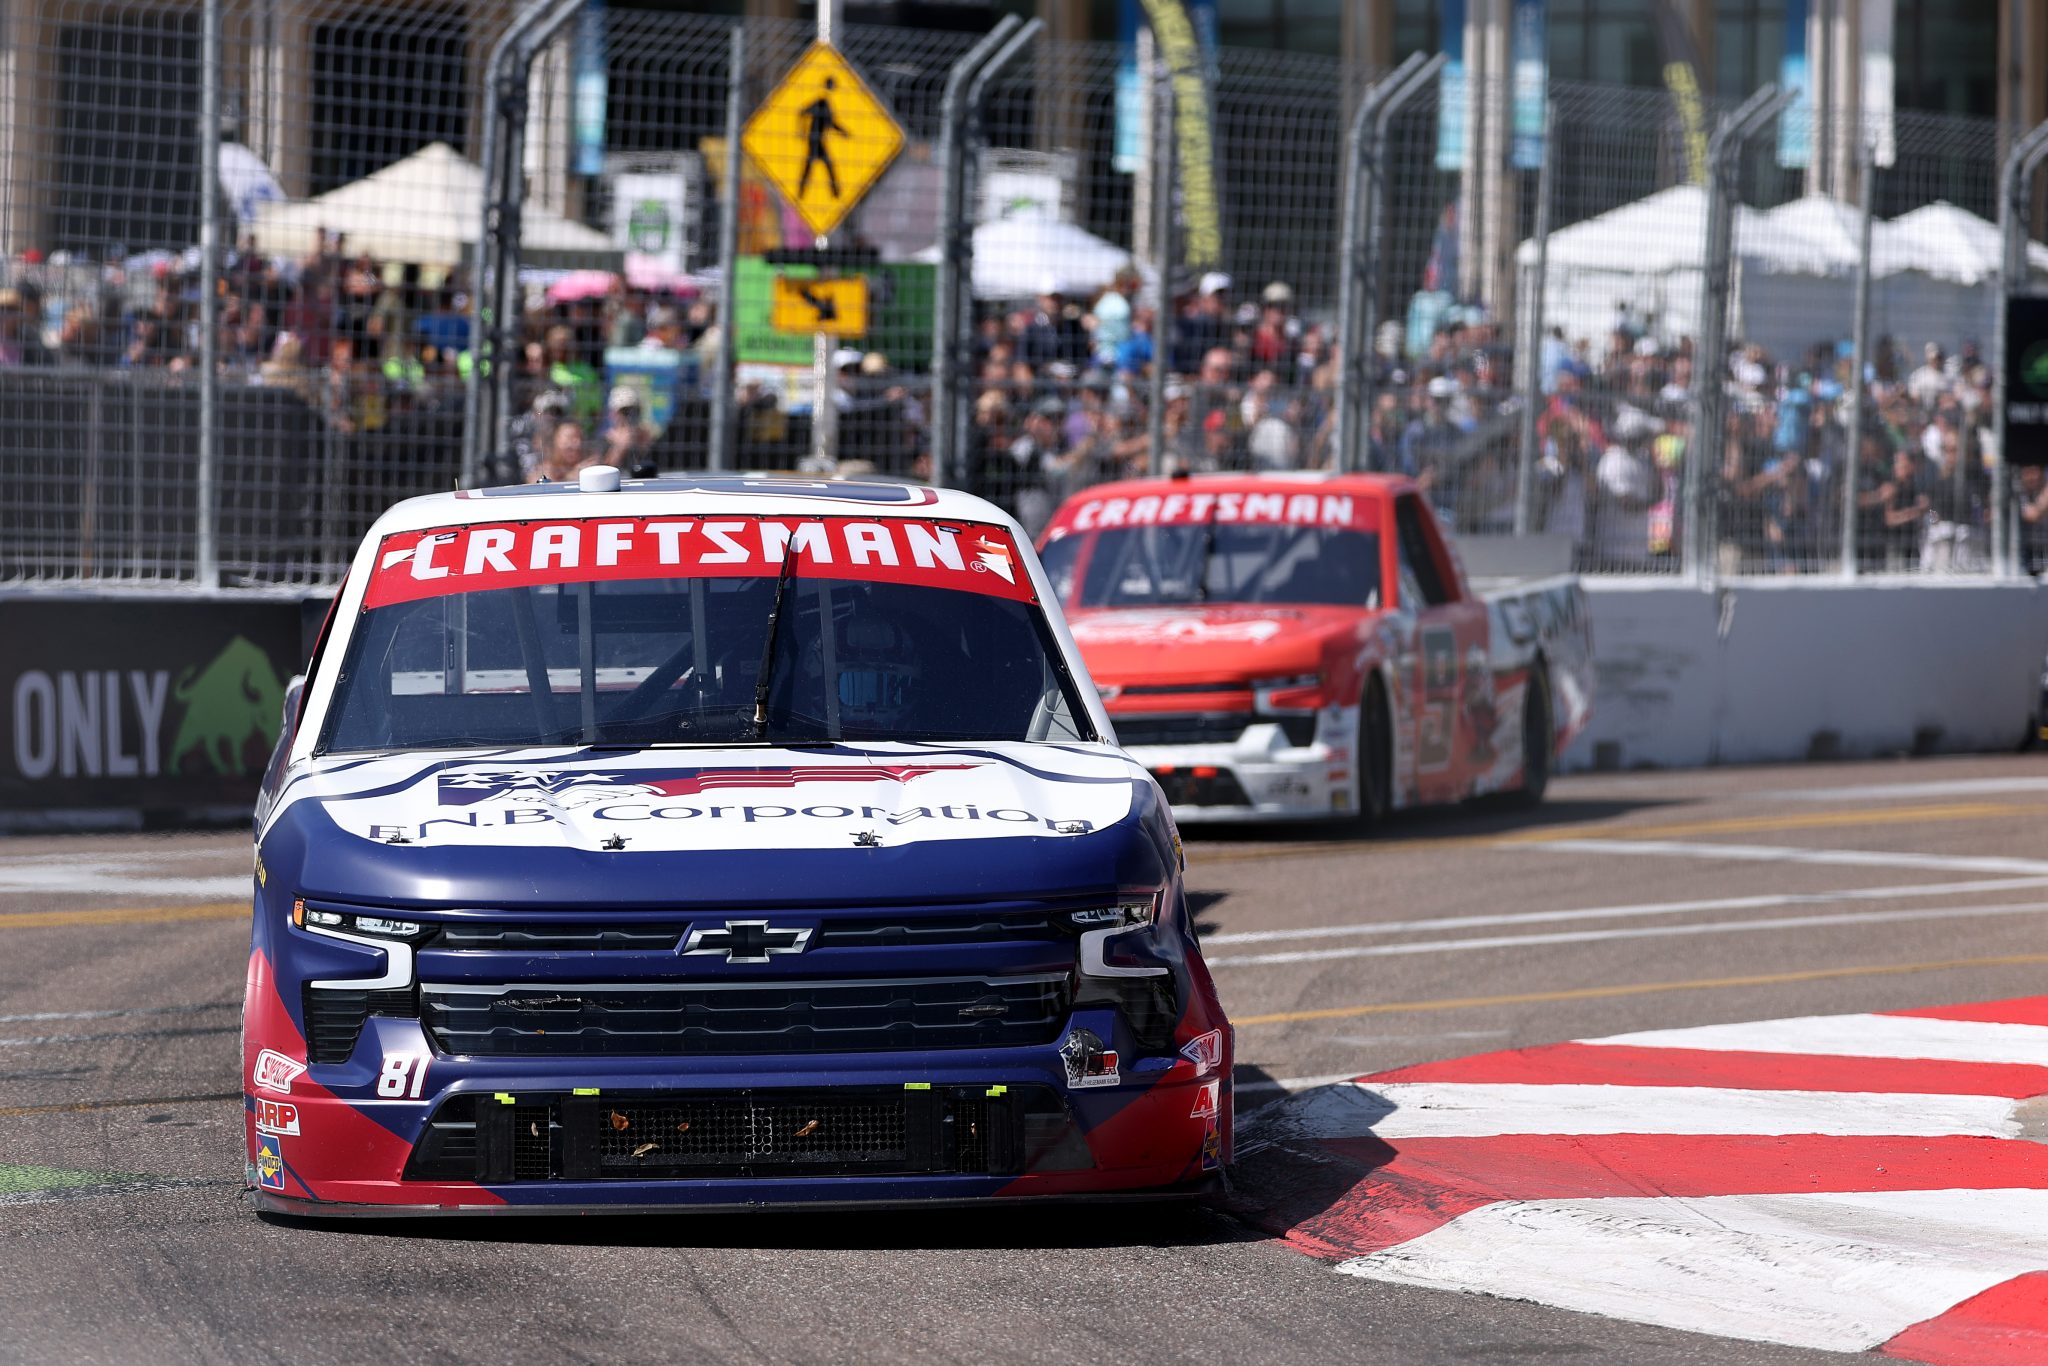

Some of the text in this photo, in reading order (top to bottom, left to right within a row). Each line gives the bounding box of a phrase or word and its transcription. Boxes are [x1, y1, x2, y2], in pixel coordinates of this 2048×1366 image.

[1073, 492, 1354, 530] CRAFTSMAN
[409, 520, 966, 582] CRAFTSMAN
[12, 669, 170, 779] ONLY
[592, 803, 1095, 833] Corporation
[377, 1055, 432, 1099] 81
[256, 1099, 297, 1129] ARP
